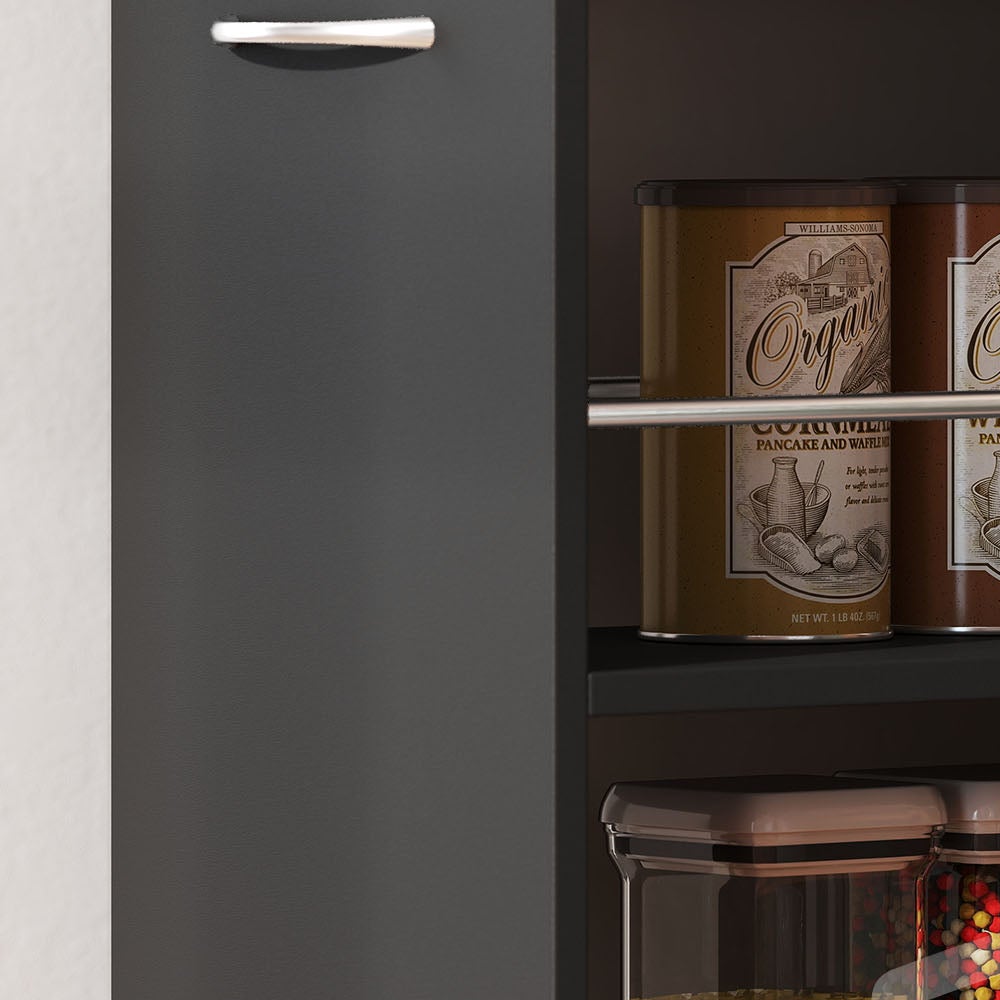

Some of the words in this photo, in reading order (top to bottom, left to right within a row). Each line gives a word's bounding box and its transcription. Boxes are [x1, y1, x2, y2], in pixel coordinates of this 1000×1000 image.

[800, 223, 878, 233] WILLIAMS-SONOMA
[756, 439, 819, 451] PANCAKE
[821, 439, 846, 450] AND
[792, 613, 810, 623] NET
[812, 613, 829, 622] WT.
[838, 613, 848, 622] LB
